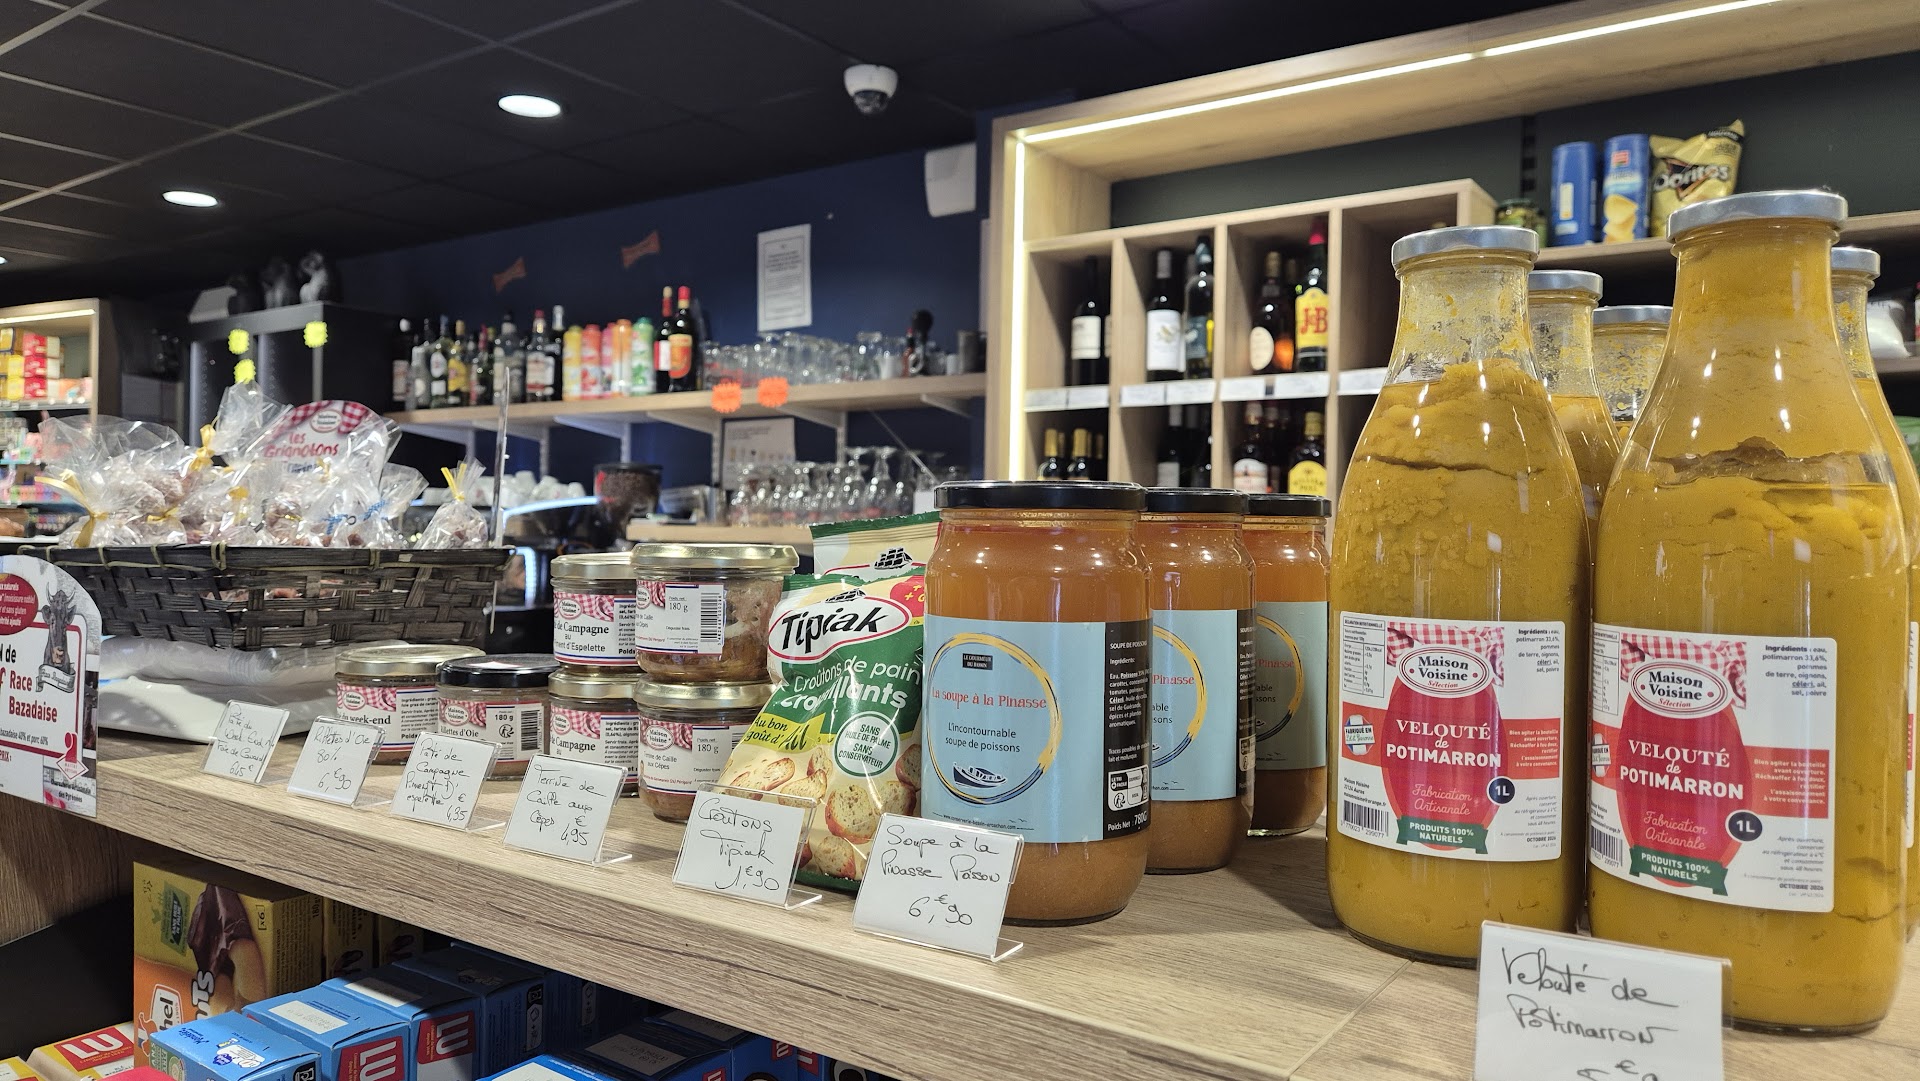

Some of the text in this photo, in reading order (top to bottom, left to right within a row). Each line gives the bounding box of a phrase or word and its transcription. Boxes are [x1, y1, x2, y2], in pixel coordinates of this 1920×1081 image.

[1654, 164, 1729, 191] Doritos
[669, 602, 682, 611] 180
[563, 622, 610, 637] Campagne
[781, 606, 889, 655] Tipiak
[1518, 628, 1548, 636] Ingrédients
[5, 644, 17, 663] de
[567, 642, 606, 652] d'Espelette
[1765, 644, 1808, 653] Ingrédients
[1258, 658, 1295, 669] Pinasse
[1418, 655, 1469, 671] Maison
[1762, 653, 1804, 661] potimarron
[794, 661, 843, 694] Croûtons
[843, 655, 922, 686] de pain
[1418, 668, 1468, 682] Voisine
[1765, 670, 1828, 680] de terre, oignons,
[9, 670, 33, 692] Race
[1153, 674, 1195, 686] Pinasse
[1427, 679, 1459, 688] Sélection
[1649, 671, 1704, 689] Maison
[1791, 680, 1828, 689] céleri, ail,
[931, 686, 1047, 710] La soupe à la Pinasse
[1649, 684, 1703, 701] Voisine
[8, 695, 58, 722] Bazadaise
[1657, 697, 1692, 708] Sélection
[350, 714, 391, 725] week-end
[754, 715, 788, 732] Au bon
[744, 730, 770, 742] goût
[859, 723, 881, 736] SANS
[948, 722, 1017, 739] L'incontournable
[1396, 719, 1491, 742] VELOUTÉ
[555, 736, 596, 753] Campagne
[697, 743, 712, 752] 180
[845, 731, 892, 750] HUILE DE PALME
[852, 742, 873, 755] SANS
[945, 736, 1021, 753] soupe de poissons
[1434, 737, 1450, 749] de
[317, 746, 341, 764] 80%
[443, 747, 463, 762] de
[838, 749, 883, 769] CONSERVATEUR
[1386, 743, 1502, 768] POTIMARRON
[1628, 738, 1730, 768] VELOUTÉ
[416, 761, 470, 780] Campagne
[1665, 759, 1682, 774] de
[1356, 780, 1370, 788] Voisine
[1619, 765, 1744, 800] POTIMARRON
[1755, 773, 1791, 781] Réchauffer
[579, 780, 607, 797] de
[1412, 784, 1472, 801] Fabrication
[1494, 785, 1510, 796] 1L
[1414, 798, 1471, 816] Artisanale
[1107, 820, 1131, 831] Poids Net
[1409, 821, 1474, 837] PRODUITS 100%
[1643, 810, 1708, 836] Fabrication
[1736, 819, 1756, 834] 1L
[560, 823, 590, 846] 4,95
[887, 824, 1000, 858] Soupe à la
[1419, 832, 1464, 844] NATURELS
[1645, 827, 1706, 851] Artisanale
[700, 829, 774, 867] Tipiak
[1641, 852, 1712, 875] PRODUITS 100%
[1650, 864, 1699, 881] NATURELS
[1502, 947, 1680, 1008] Velouté de
[1506, 993, 1680, 1045] Potimarron
[436, 1014, 470, 1055] LU
[61, 1033, 124, 1060] LU
[359, 1040, 397, 1081] LU
